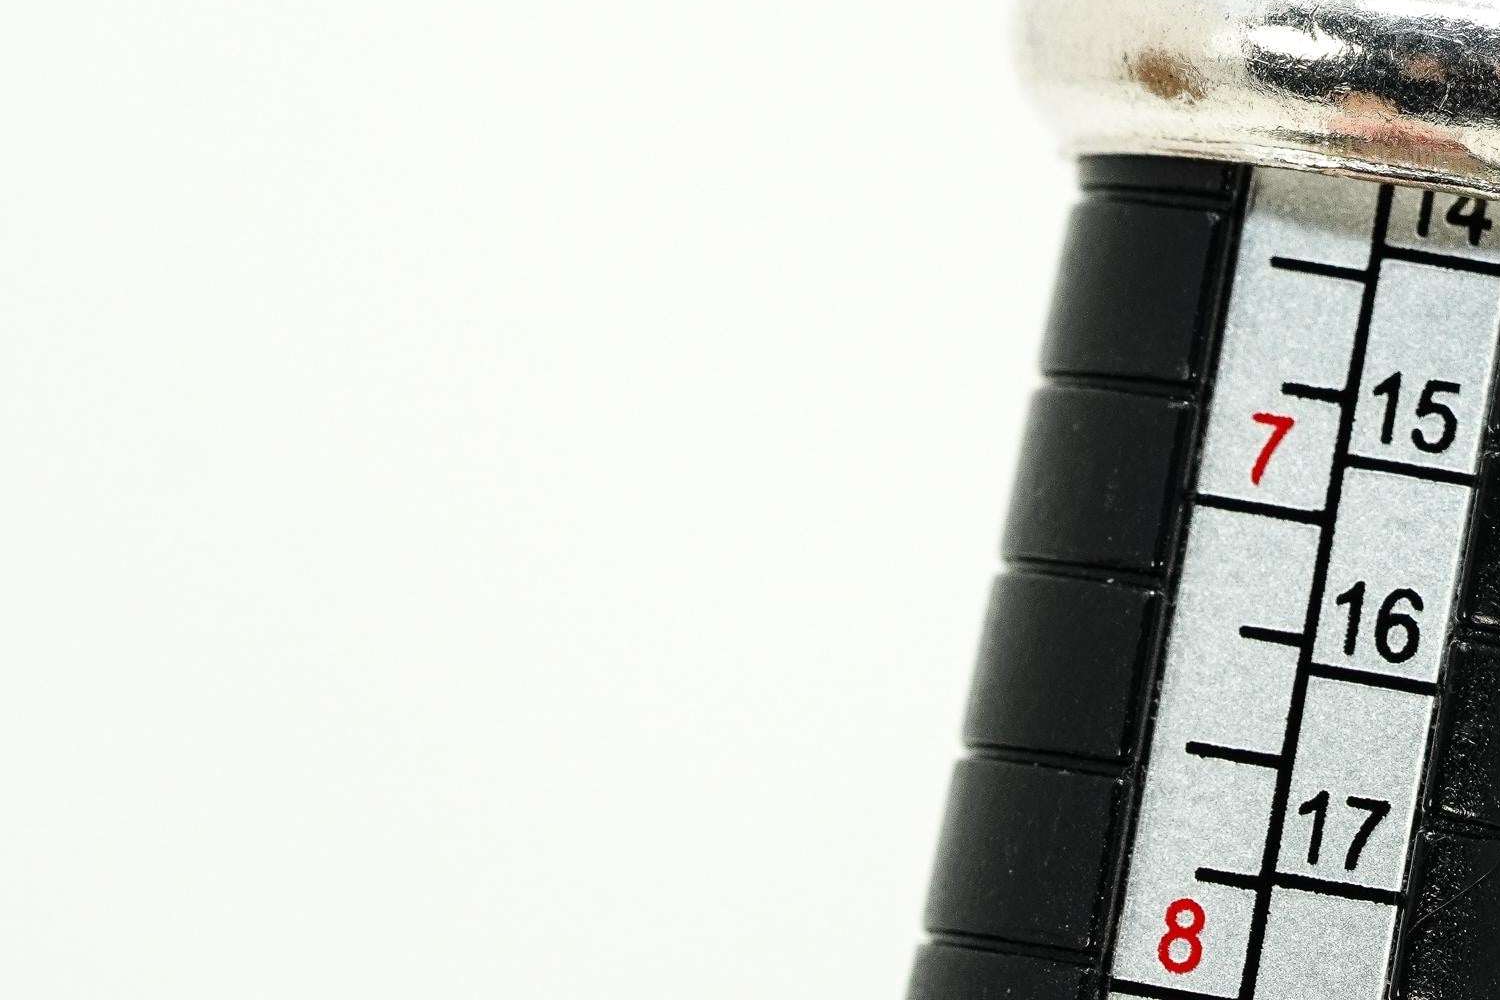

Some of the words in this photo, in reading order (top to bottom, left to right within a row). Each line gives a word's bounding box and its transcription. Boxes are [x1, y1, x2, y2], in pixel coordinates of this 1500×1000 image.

[1416, 190, 1492, 246] 14
[1251, 412, 1295, 486] 7
[1372, 370, 1462, 454] 15
[1335, 580, 1425, 665] 16
[1297, 789, 1392, 872] 17
[1157, 897, 1206, 975] 8
